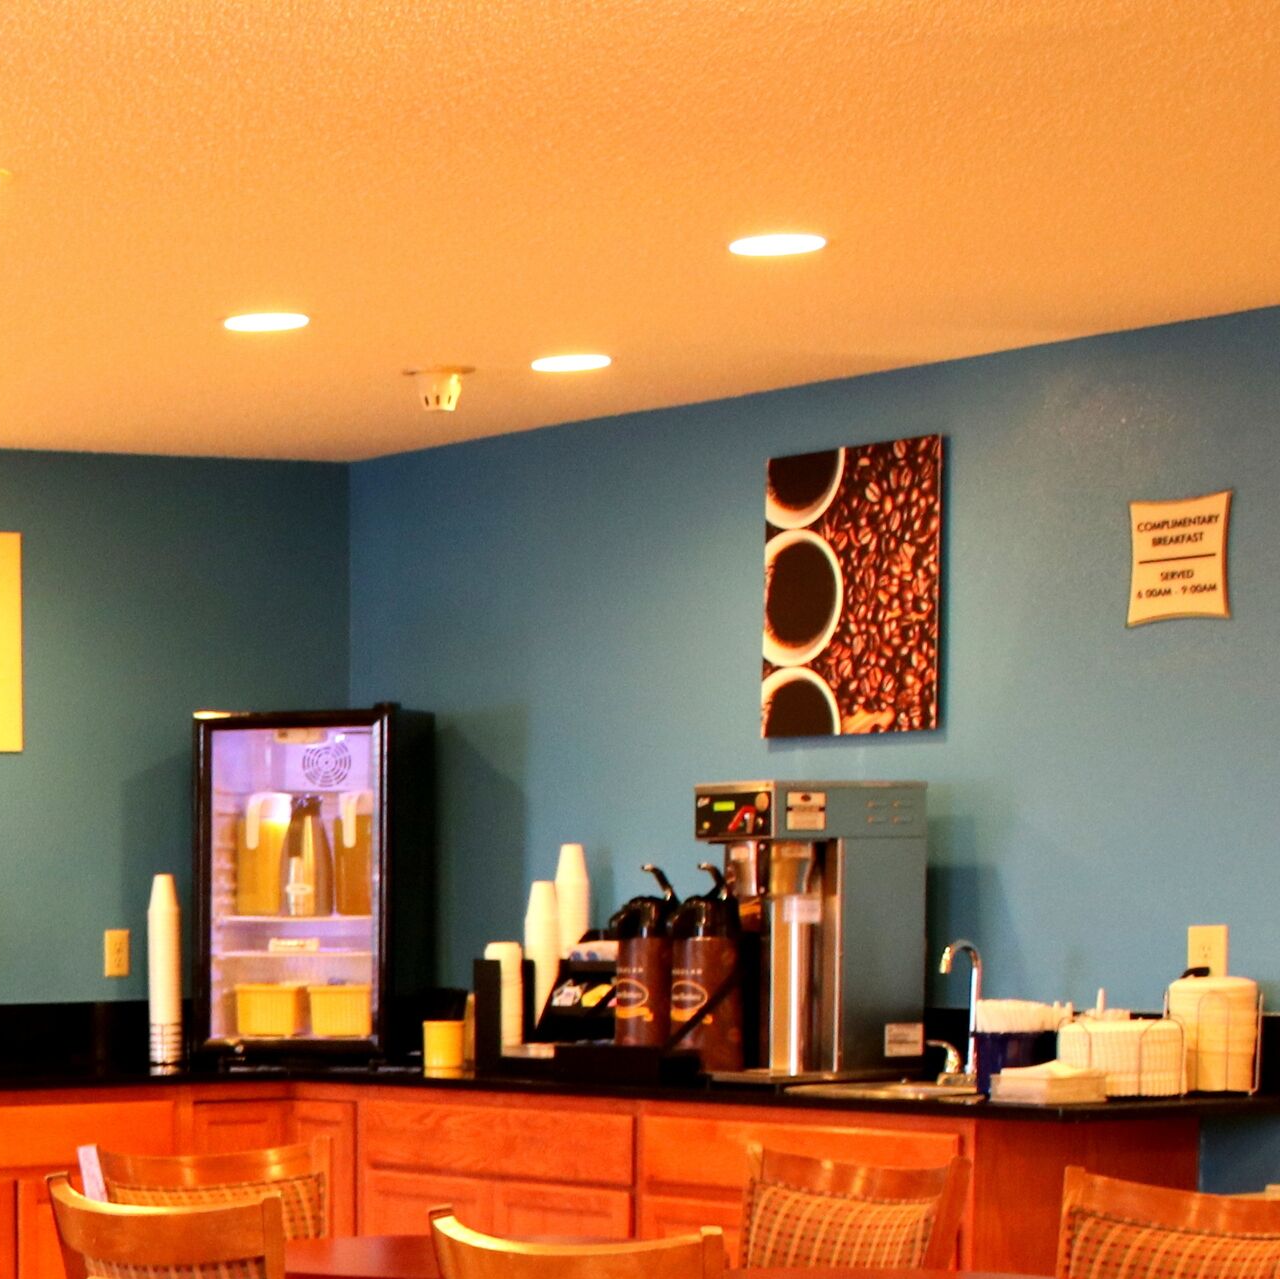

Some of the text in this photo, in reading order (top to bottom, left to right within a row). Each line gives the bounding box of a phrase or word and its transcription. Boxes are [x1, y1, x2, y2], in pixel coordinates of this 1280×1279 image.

[1137, 513, 1220, 533] COMPLIMENTARY
[1151, 532, 1204, 547] BREAKFAST
[1160, 569, 1195, 581] SERVED
